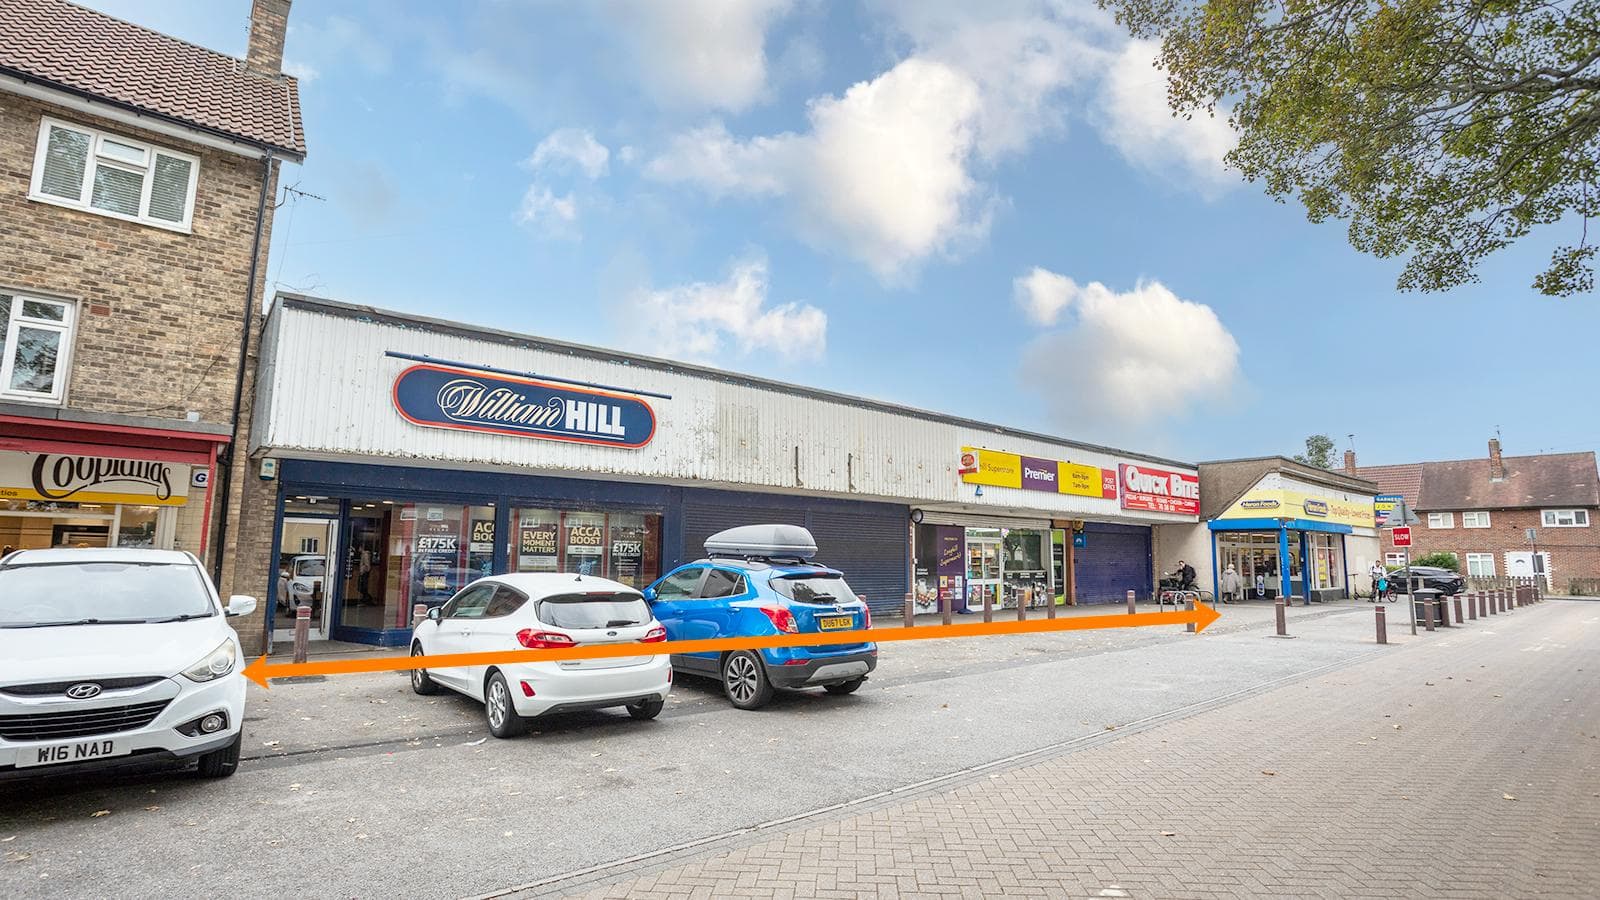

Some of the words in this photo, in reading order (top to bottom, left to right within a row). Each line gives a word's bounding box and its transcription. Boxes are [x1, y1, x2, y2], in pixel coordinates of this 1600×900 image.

[437, 379, 565, 429] William
[565, 400, 626, 436] HILL
[1024, 467, 1055, 482] Premier
[1126, 465, 1169, 496] QUICK
[1170, 474, 1199, 499] BITE
[474, 522, 494, 532] AC
[570, 527, 601, 537] ACCA
[523, 531, 556, 540] EVERY
[570, 536, 601, 545] BOOST
[418, 537, 457, 549] £175K
[612, 543, 642, 553] £175K
[37, 746, 69, 763] W16
[75, 740, 113, 758] NAD
